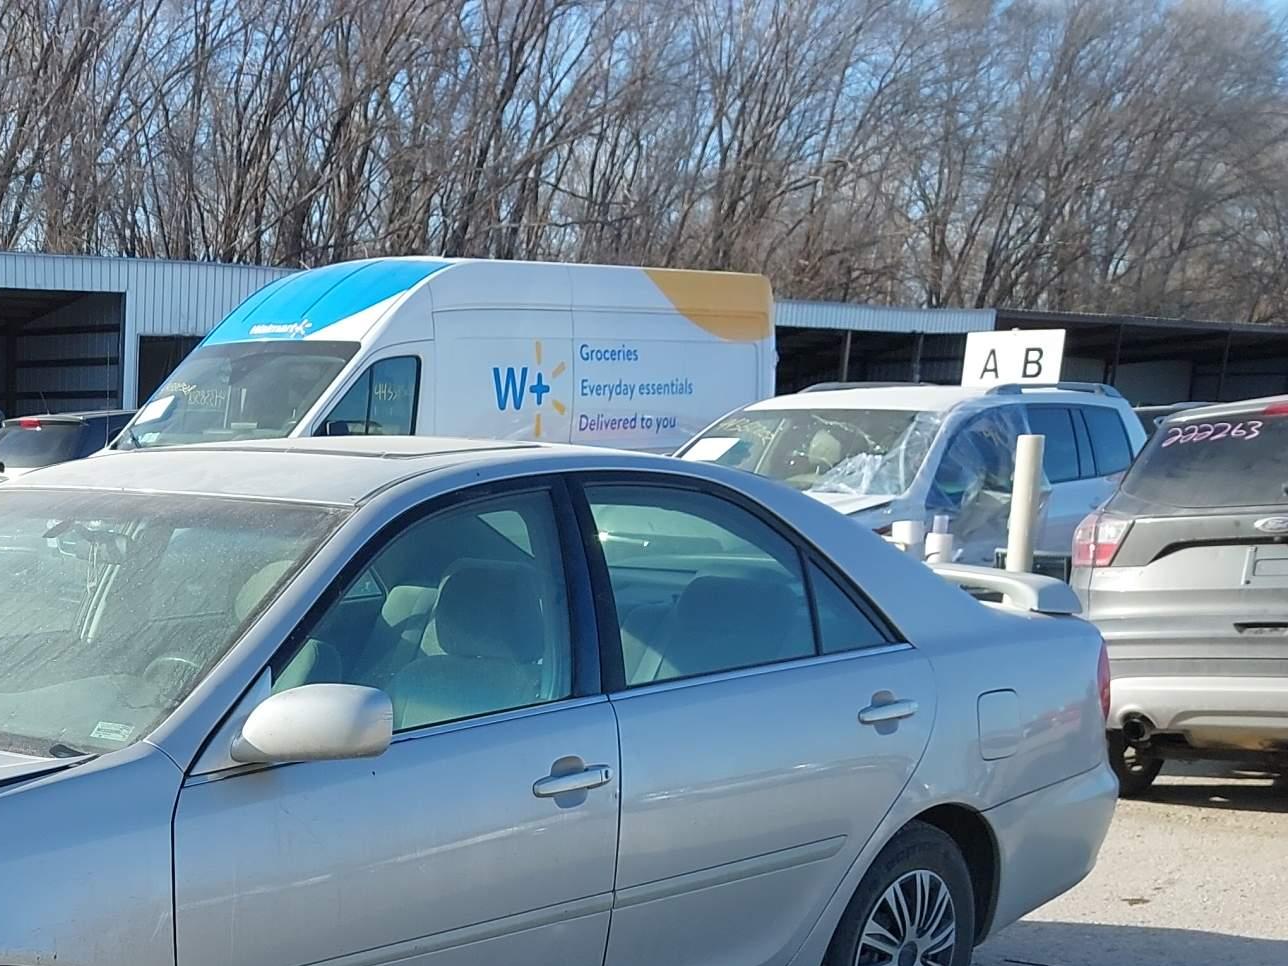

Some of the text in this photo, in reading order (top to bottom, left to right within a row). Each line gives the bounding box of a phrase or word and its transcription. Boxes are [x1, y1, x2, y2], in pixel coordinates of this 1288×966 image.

[579, 344, 638, 362] Groceries
[979, 347, 1043, 379] A B
[580, 377, 693, 401] Everyday essentials
[578, 413, 677, 434] Delivered to you
[1161, 420, 1263, 447] 222263
